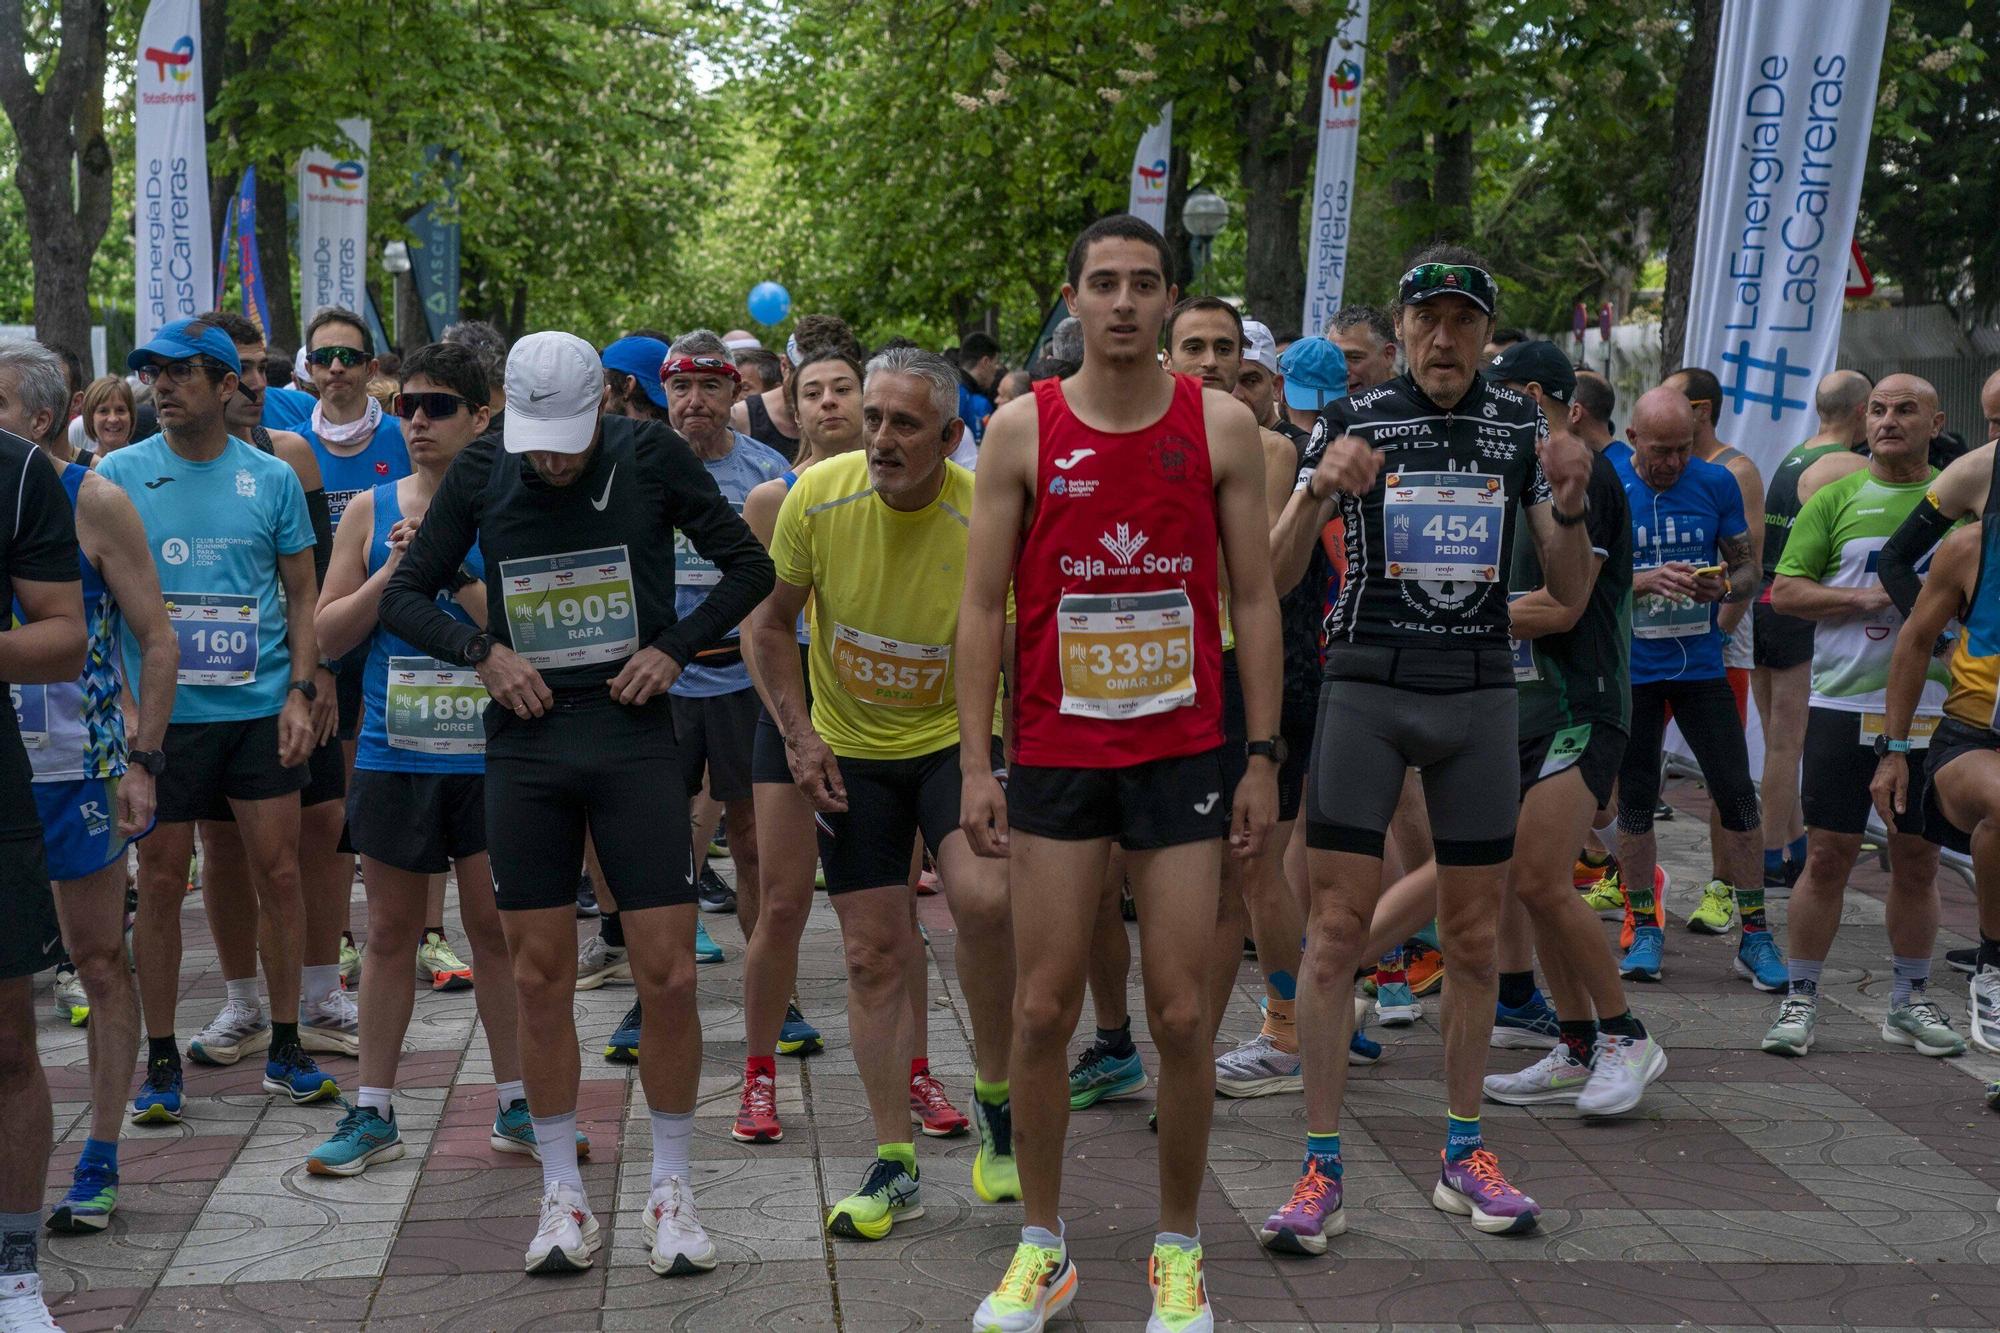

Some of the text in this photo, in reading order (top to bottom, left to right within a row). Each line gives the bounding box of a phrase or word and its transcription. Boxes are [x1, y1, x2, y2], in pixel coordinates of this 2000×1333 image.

[1724, 55, 1788, 330] LaEnergíaDe
[1769, 54, 1847, 332] LasCarreras
[169, 157, 196, 317] asCarreras
[314, 236, 333, 306] ergíaDe
[1349, 387, 1396, 411] fugitive
[1374, 424, 1432, 440] KUOTA
[1478, 425, 1511, 438] HED
[1422, 514, 1489, 543] 454
[1434, 545, 1478, 556] PEDRO
[1059, 555, 1105, 581] Caja
[1107, 565, 1128, 576] rural
[1129, 565, 1141, 575] de
[536, 591, 630, 629] 1905
[568, 626, 605, 640] RAFA
[1388, 619, 1495, 635] VELO CULT
[191, 629, 248, 654] 160
[206, 655, 232, 664] JAVI
[1089, 638, 1188, 676] 3395
[854, 656, 944, 690] 3357
[1106, 675, 1148, 690] OMAR
[433, 722, 475, 732] JORGE
